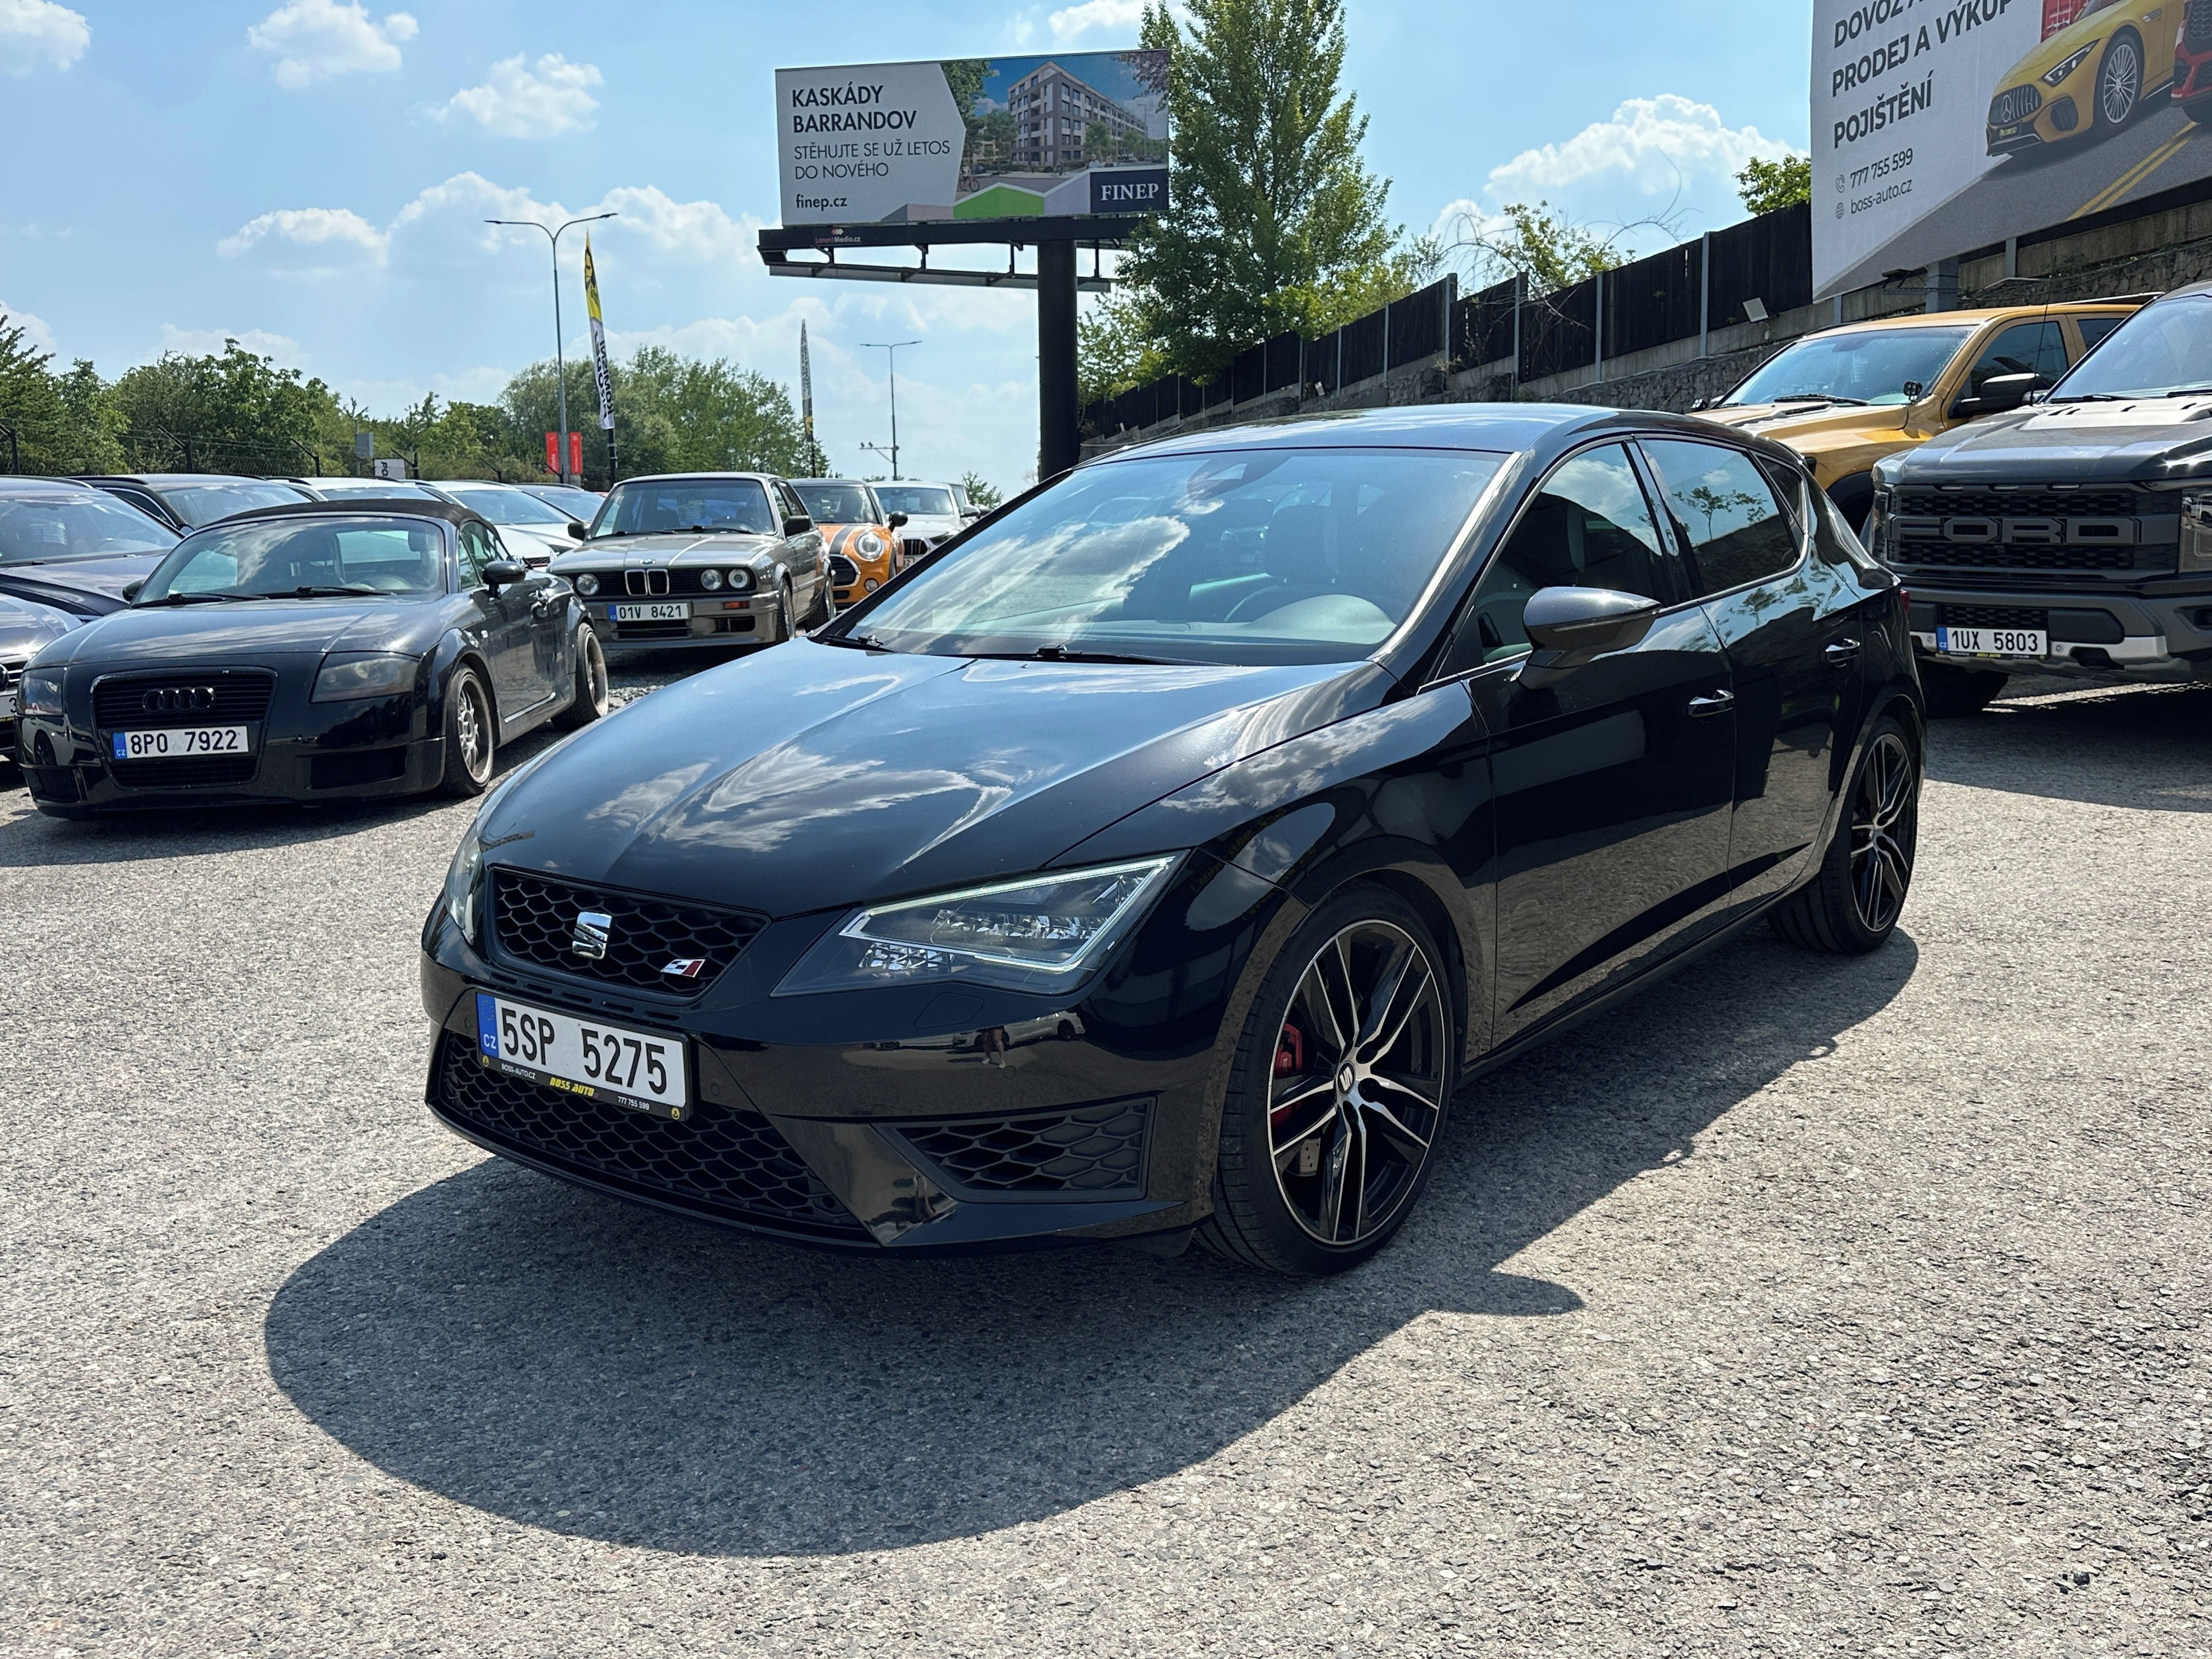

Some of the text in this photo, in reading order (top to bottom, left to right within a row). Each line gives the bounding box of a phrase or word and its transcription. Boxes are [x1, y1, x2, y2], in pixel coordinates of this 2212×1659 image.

[1834, 0, 1903, 49] DOVOZ
[1832, 33, 1910, 98] PRODEJ
[1914, 25, 1931, 58] A
[792, 81, 884, 108] KASKÁDY
[1834, 69, 1934, 149] POJIŠTĚNÍ
[793, 110, 917, 133] BARRANDOV
[794, 138, 950, 160] STĚHUJTE SE UŽ LETOS
[795, 159, 889, 180] DO NOVÉHO
[1850, 148, 1914, 189] 777 755 599
[795, 193, 848, 211] finep.cz
[1100, 183, 1159, 201] FINEP
[1850, 179, 1913, 215] boss-auto.cz
[1891, 516, 2137, 545] FORD
[619, 605, 681, 619] 01V 8421
[1951, 630, 2038, 652] 1UX 5803
[130, 729, 238, 755] 8P0 7922
[483, 1033, 496, 1049] CZ
[501, 1007, 668, 1095] 5SP 5275
[501, 1063, 536, 1080] BOSS-AUTO.CZ
[550, 1076, 571, 1090] BOSS
[571, 1083, 595, 1097] AUTO
[617, 1095, 650, 1110] 777 755 599
